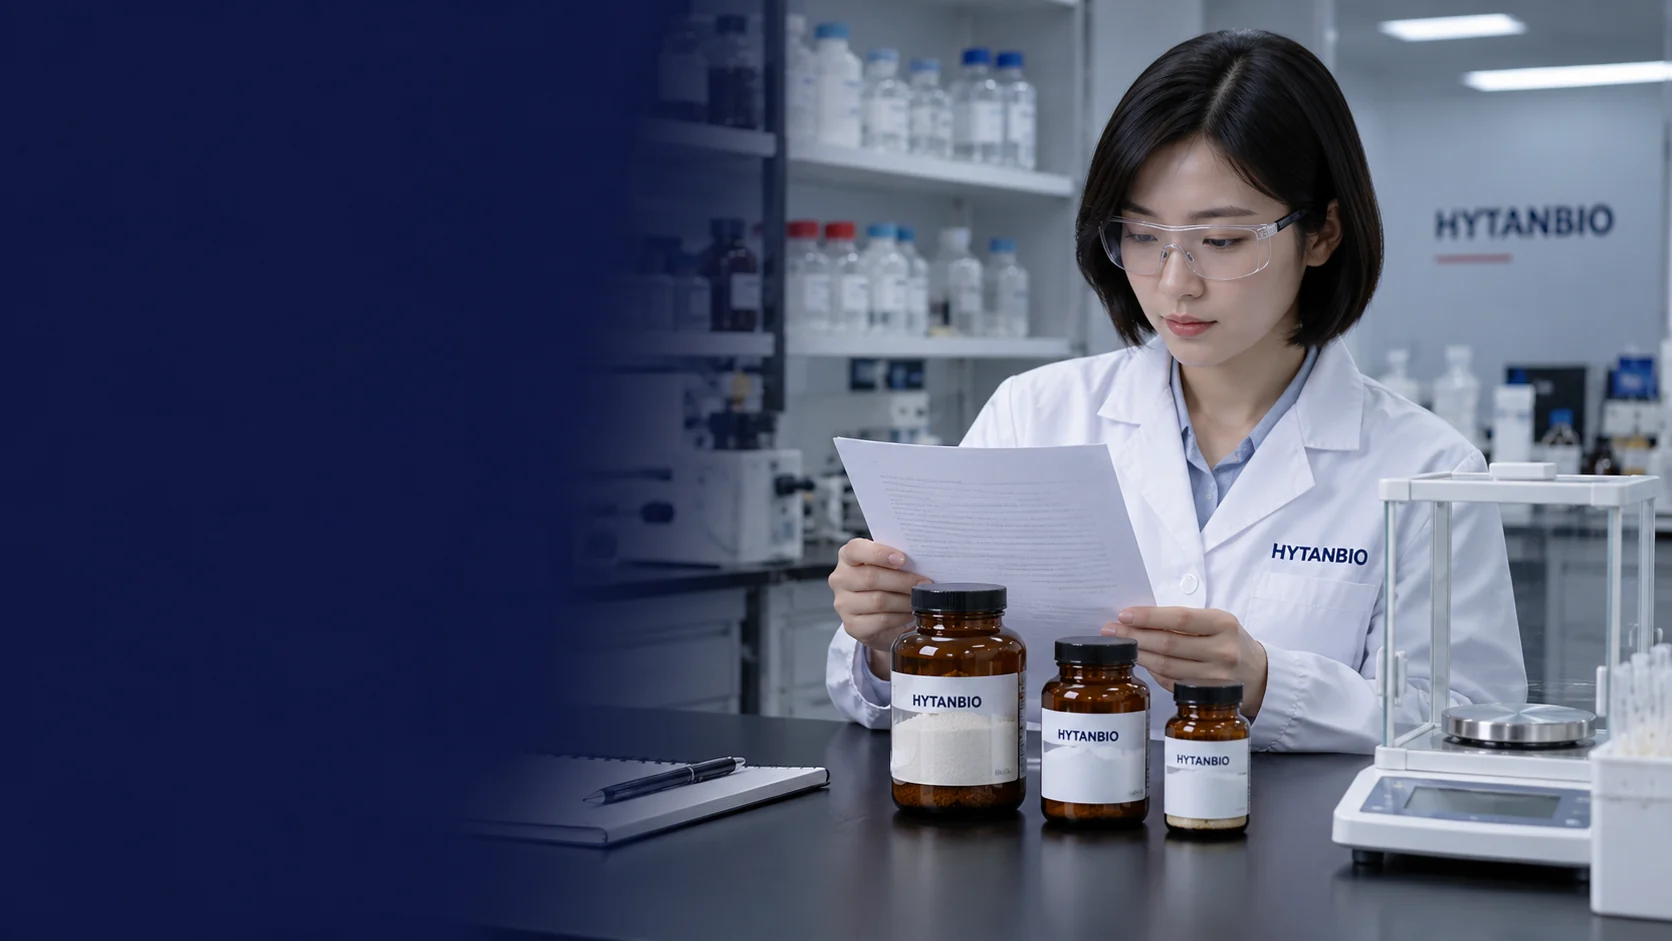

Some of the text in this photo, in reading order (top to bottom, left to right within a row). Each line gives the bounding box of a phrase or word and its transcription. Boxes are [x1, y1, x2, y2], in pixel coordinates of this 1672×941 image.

[1435, 204, 1614, 239] HYTANBIO
[1271, 542, 1368, 566] HYTANBIO
[912, 694, 982, 708] HYTANBIO
[1058, 728, 1119, 742] HYTANBIO
[1177, 754, 1230, 766] HYTANBIO
